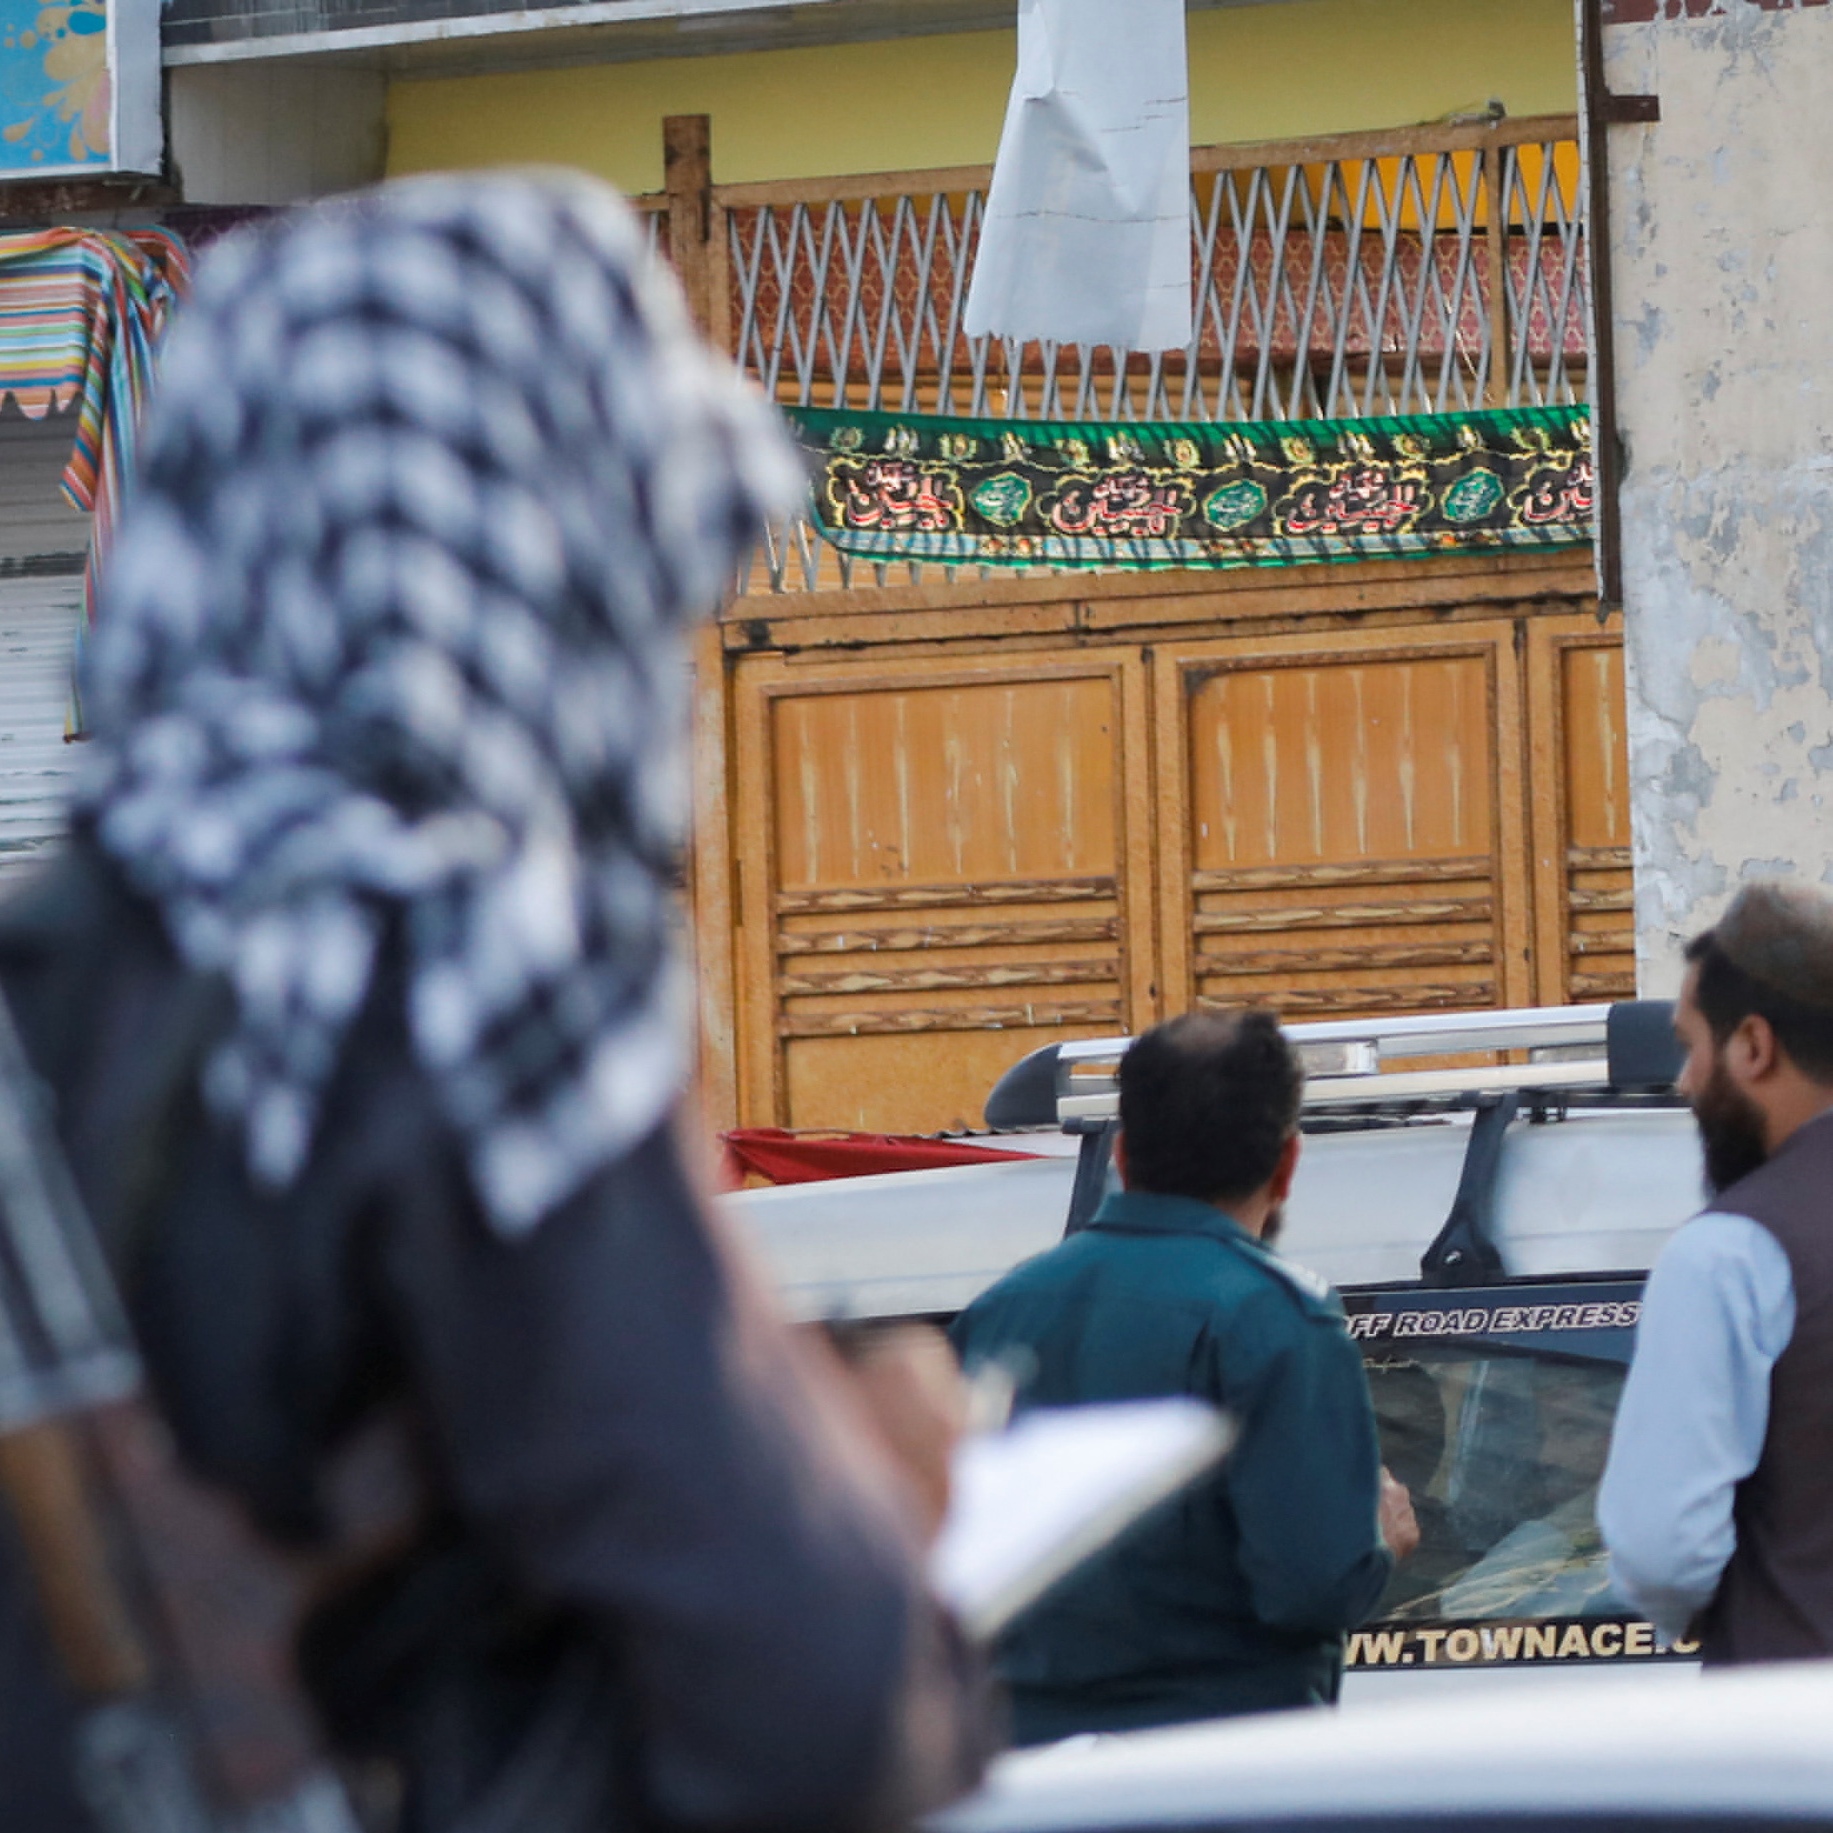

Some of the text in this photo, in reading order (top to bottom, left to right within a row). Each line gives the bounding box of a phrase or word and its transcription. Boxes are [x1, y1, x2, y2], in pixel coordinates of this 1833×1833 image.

[1341, 1301, 1645, 1341] FF ROAD EXPRESS
